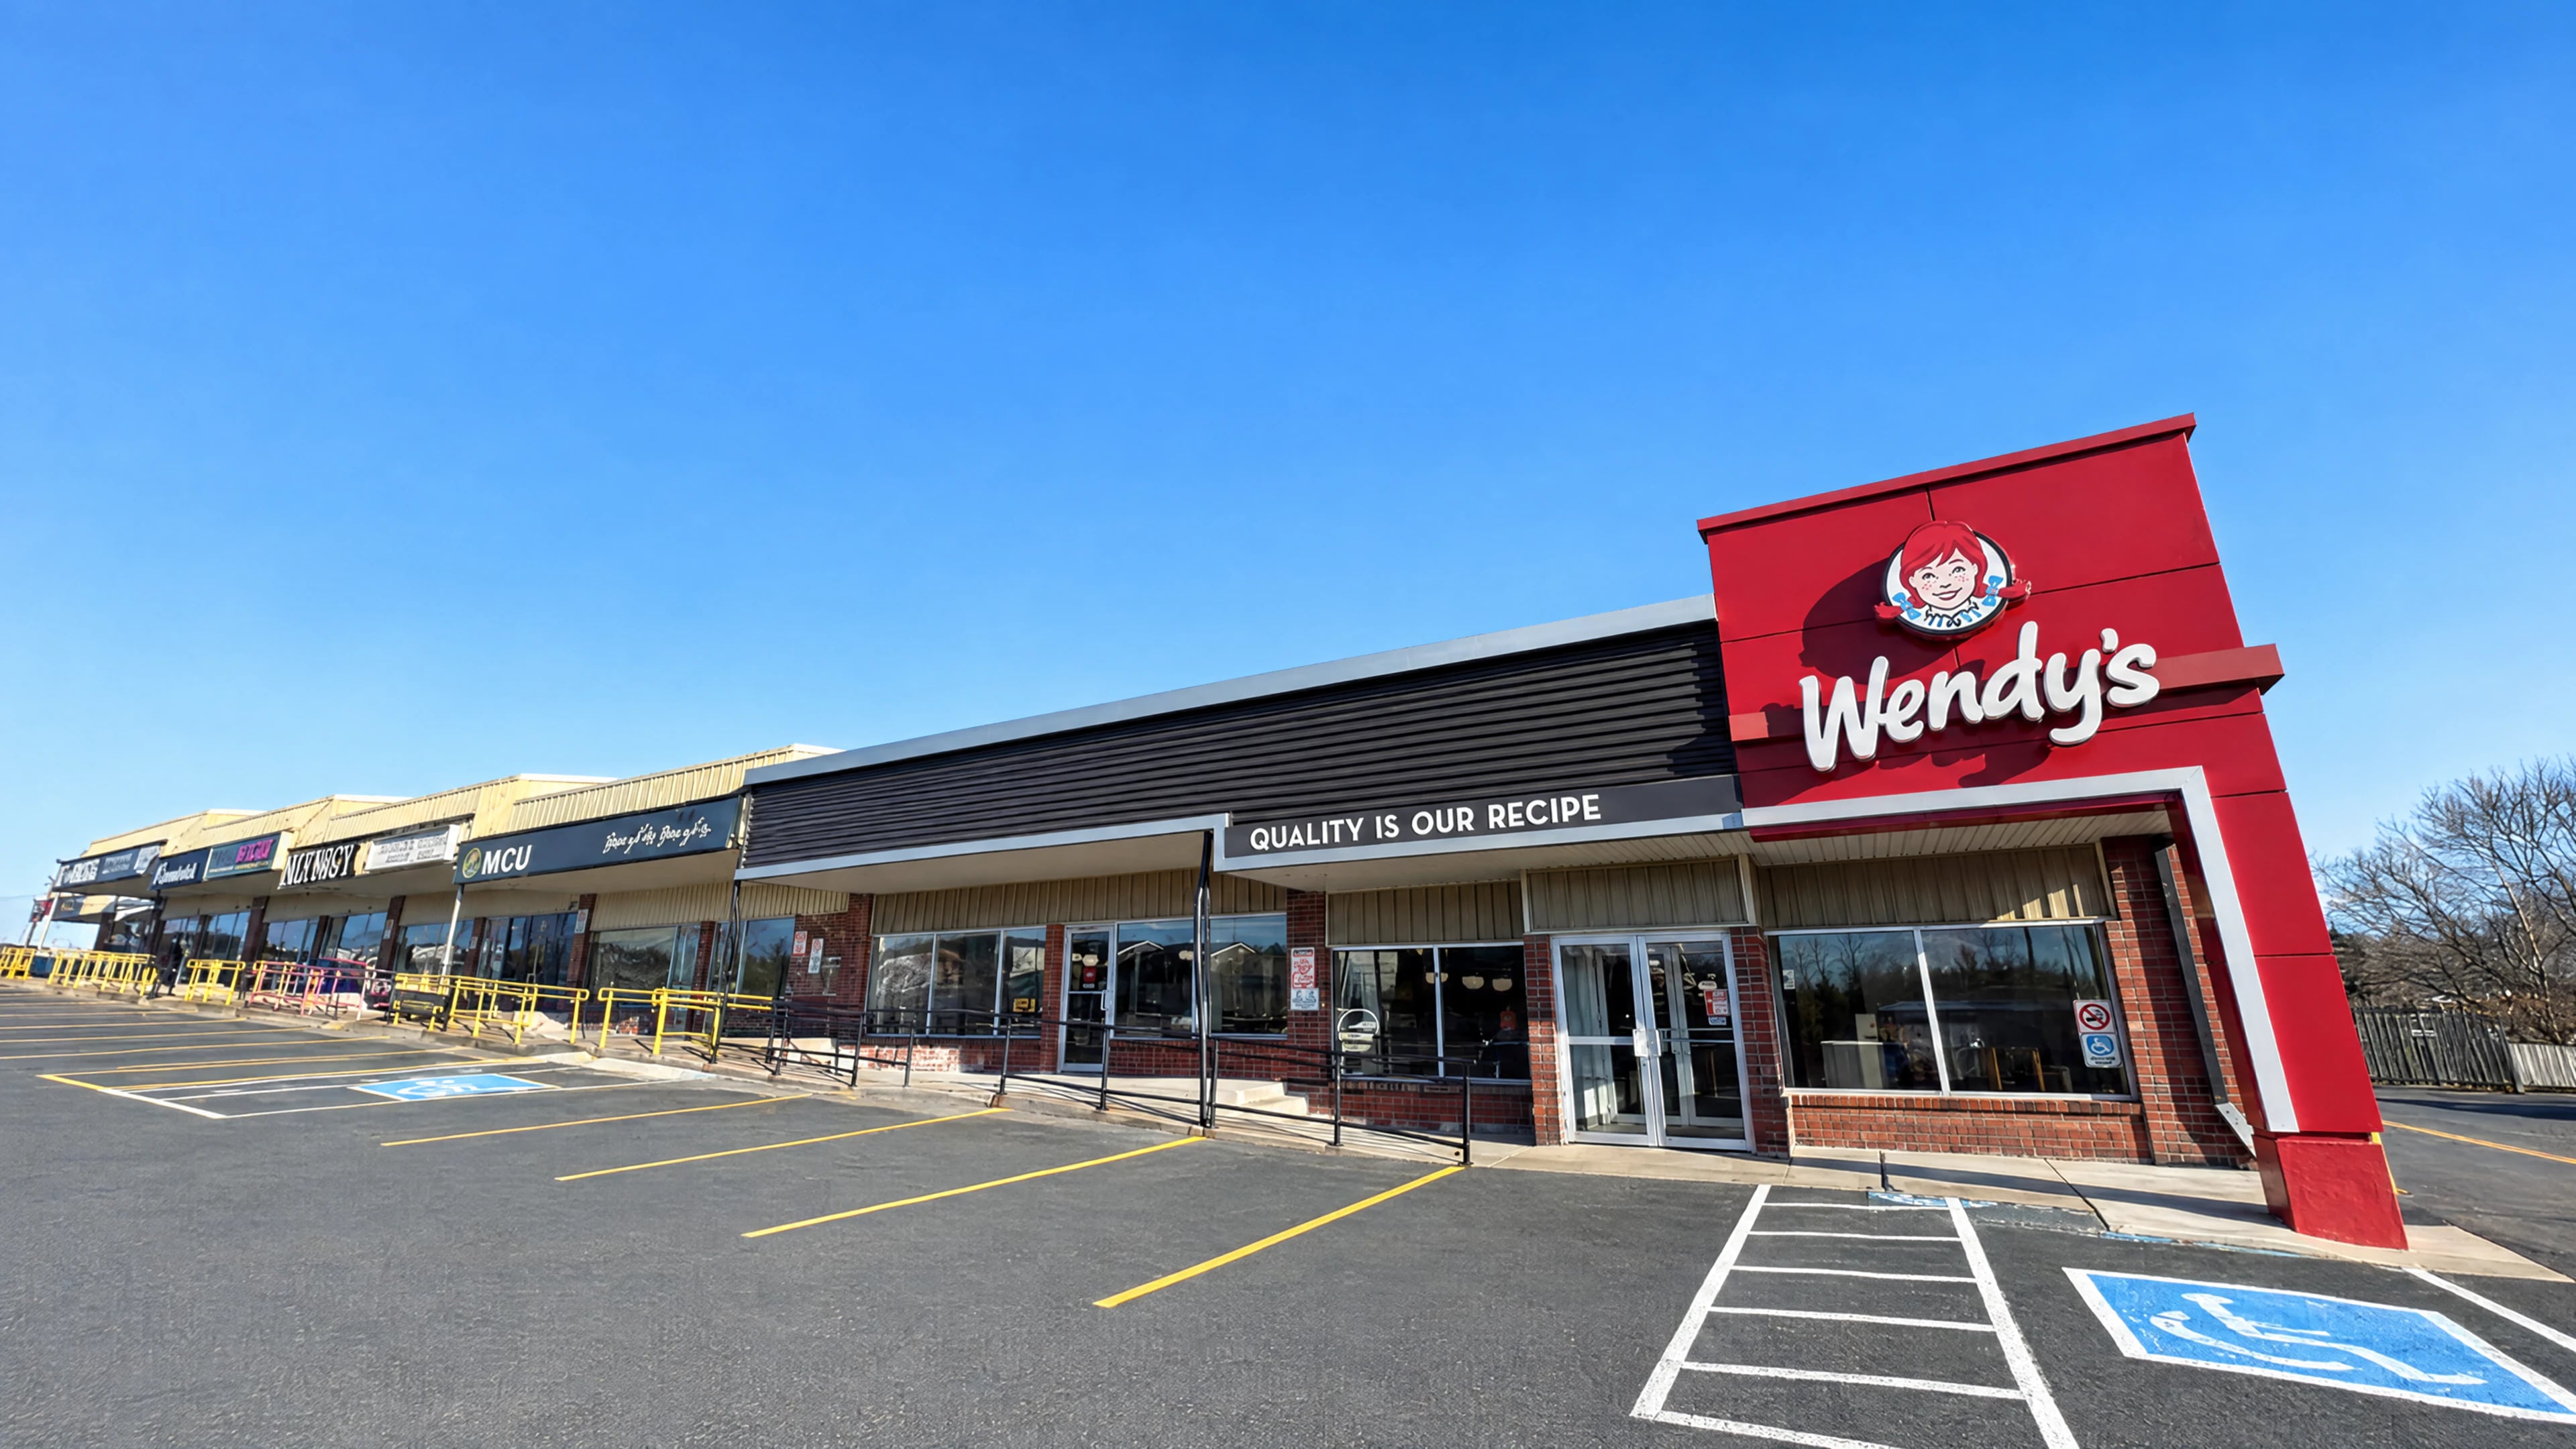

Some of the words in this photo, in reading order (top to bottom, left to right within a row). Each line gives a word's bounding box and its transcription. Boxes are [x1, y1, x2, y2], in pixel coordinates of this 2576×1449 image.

[1799, 621, 2161, 772] Wendy's
[1250, 817, 1364, 851] QUALITY
[1375, 814, 1399, 839] IS
[1411, 807, 1474, 835] OUR
[1488, 794, 1601, 829] RECIPE
[481, 845, 533, 875] MCU
